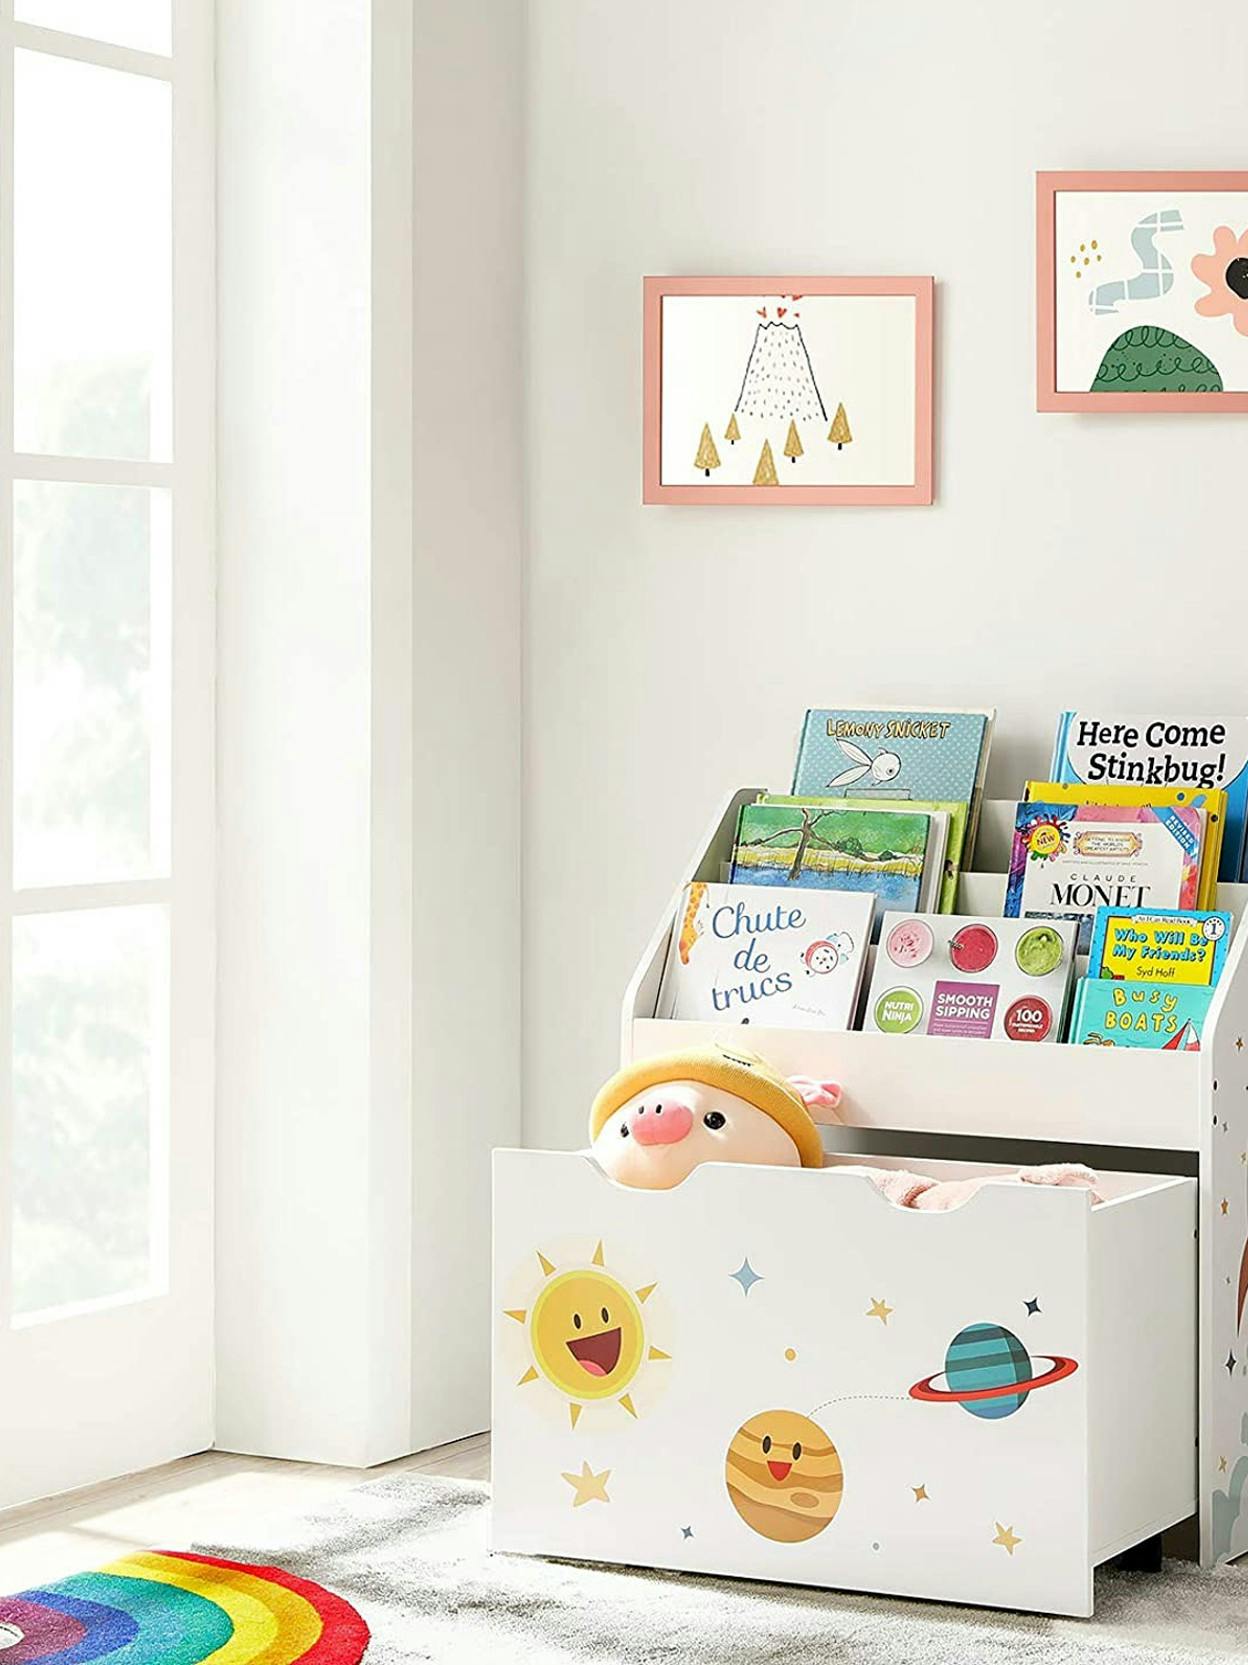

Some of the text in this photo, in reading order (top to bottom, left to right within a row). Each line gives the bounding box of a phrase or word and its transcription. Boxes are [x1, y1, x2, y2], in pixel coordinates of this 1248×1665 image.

[826, 718, 885, 738] LEMONY
[1077, 721, 1226, 748] Here Come
[1088, 752, 1226, 789] Stinkbug!
[1165, 820, 1190, 849] EDITION
[1170, 815, 1194, 843] REVISED
[1036, 833, 1056, 847] NEW
[1070, 873, 1136, 882] CLAUDE
[1049, 883, 1151, 907] MONET
[712, 902, 807, 939] Chute
[1211, 923, 1217, 935] 1
[1114, 928, 1148, 942] Who
[1154, 930, 1185, 945] Will
[733, 937, 772, 973] de
[1112, 944, 1206, 962] My Friends?
[1136, 966, 1176, 977] Syd Hoff
[712, 972, 793, 1011] trucs
[936, 993, 993, 1008] SMOOTH
[884, 1001, 914, 1012] NUTRI
[935, 1005, 991, 1020] SIPPING
[1015, 1008, 1043, 1023] 100
[882, 1010, 913, 1024] NINJA
[1105, 1010, 1178, 1033] BOATS
